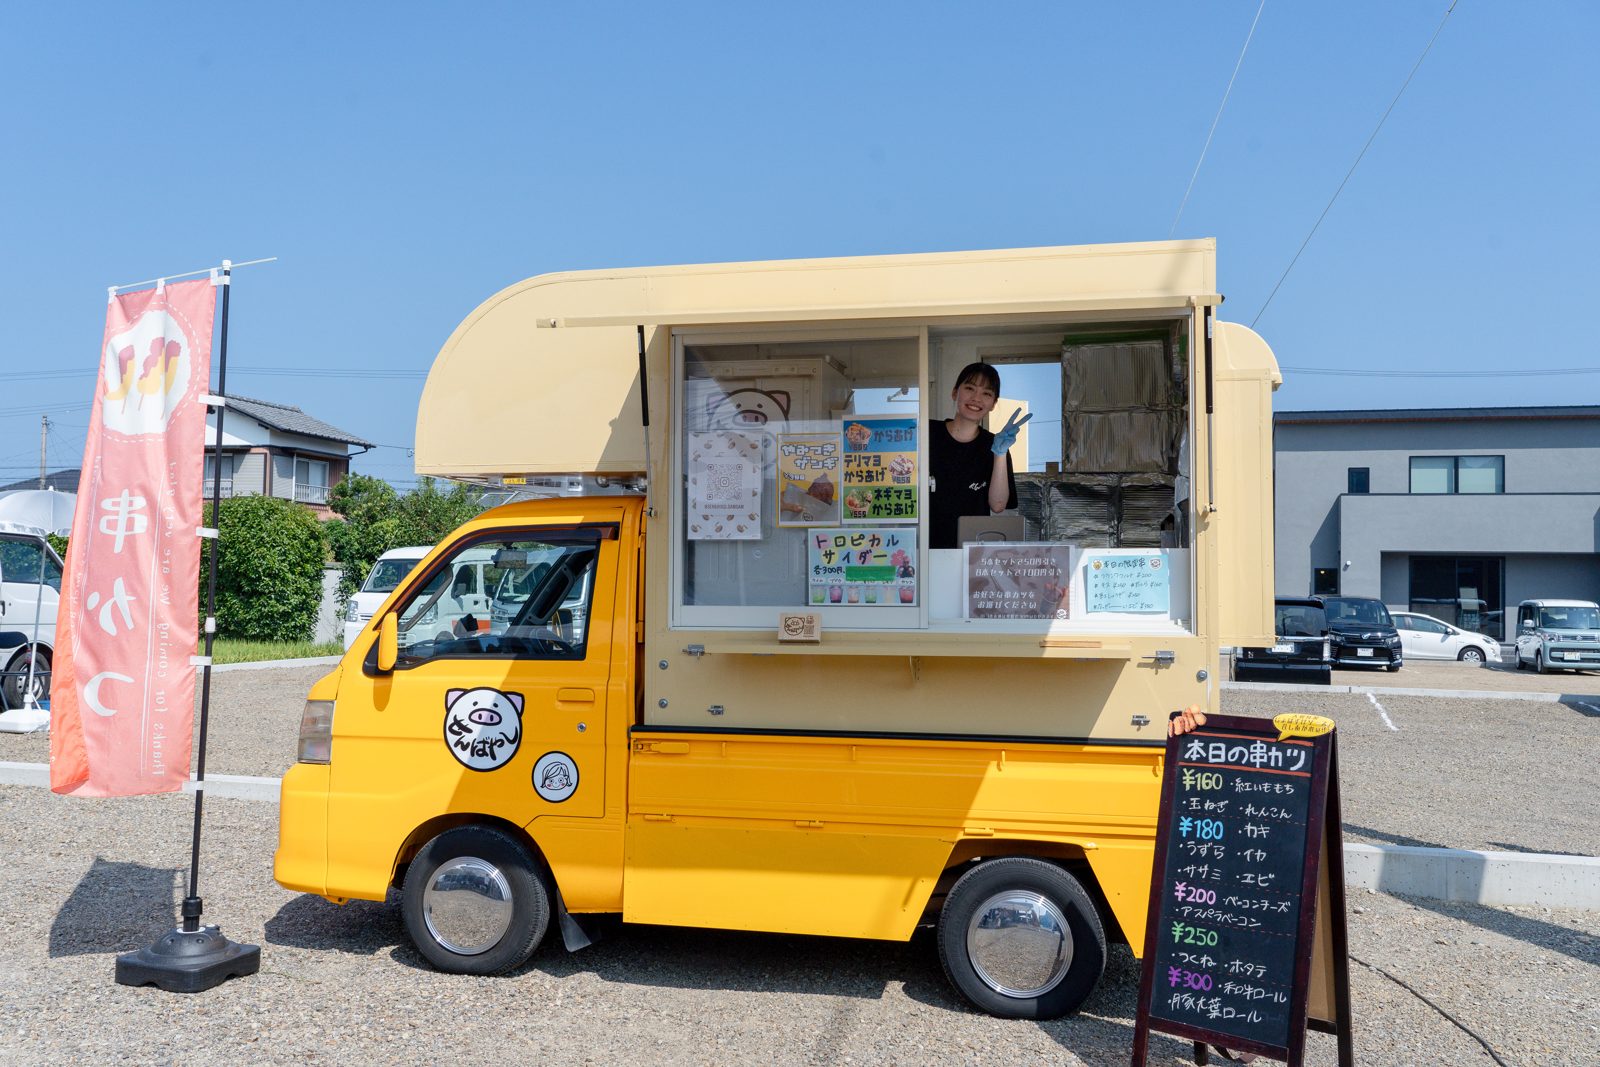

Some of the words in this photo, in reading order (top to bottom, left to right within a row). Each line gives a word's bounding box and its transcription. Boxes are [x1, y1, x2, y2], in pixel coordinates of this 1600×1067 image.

[873, 426, 916, 442] からあげ
[781, 443, 836, 456] やみつき
[794, 456, 839, 470] ザンギ
[844, 454, 882, 468] テリマヨ
[844, 467, 887, 483] からあげ
[874, 487, 913, 501] ネギマヨ
[872, 500, 917, 516] からあげ
[815, 534, 899, 549] トロピカル
[822, 549, 888, 564] サイダー
[1184, 739, 1306, 771] 本日の串カツ
[1182, 768, 1223, 791] ¥160
[1178, 815, 1224, 840] ¥180
[1174, 881, 1217, 905] ¥200
[1171, 921, 1218, 947] ¥250
[1168, 966, 1213, 991] ¥300
